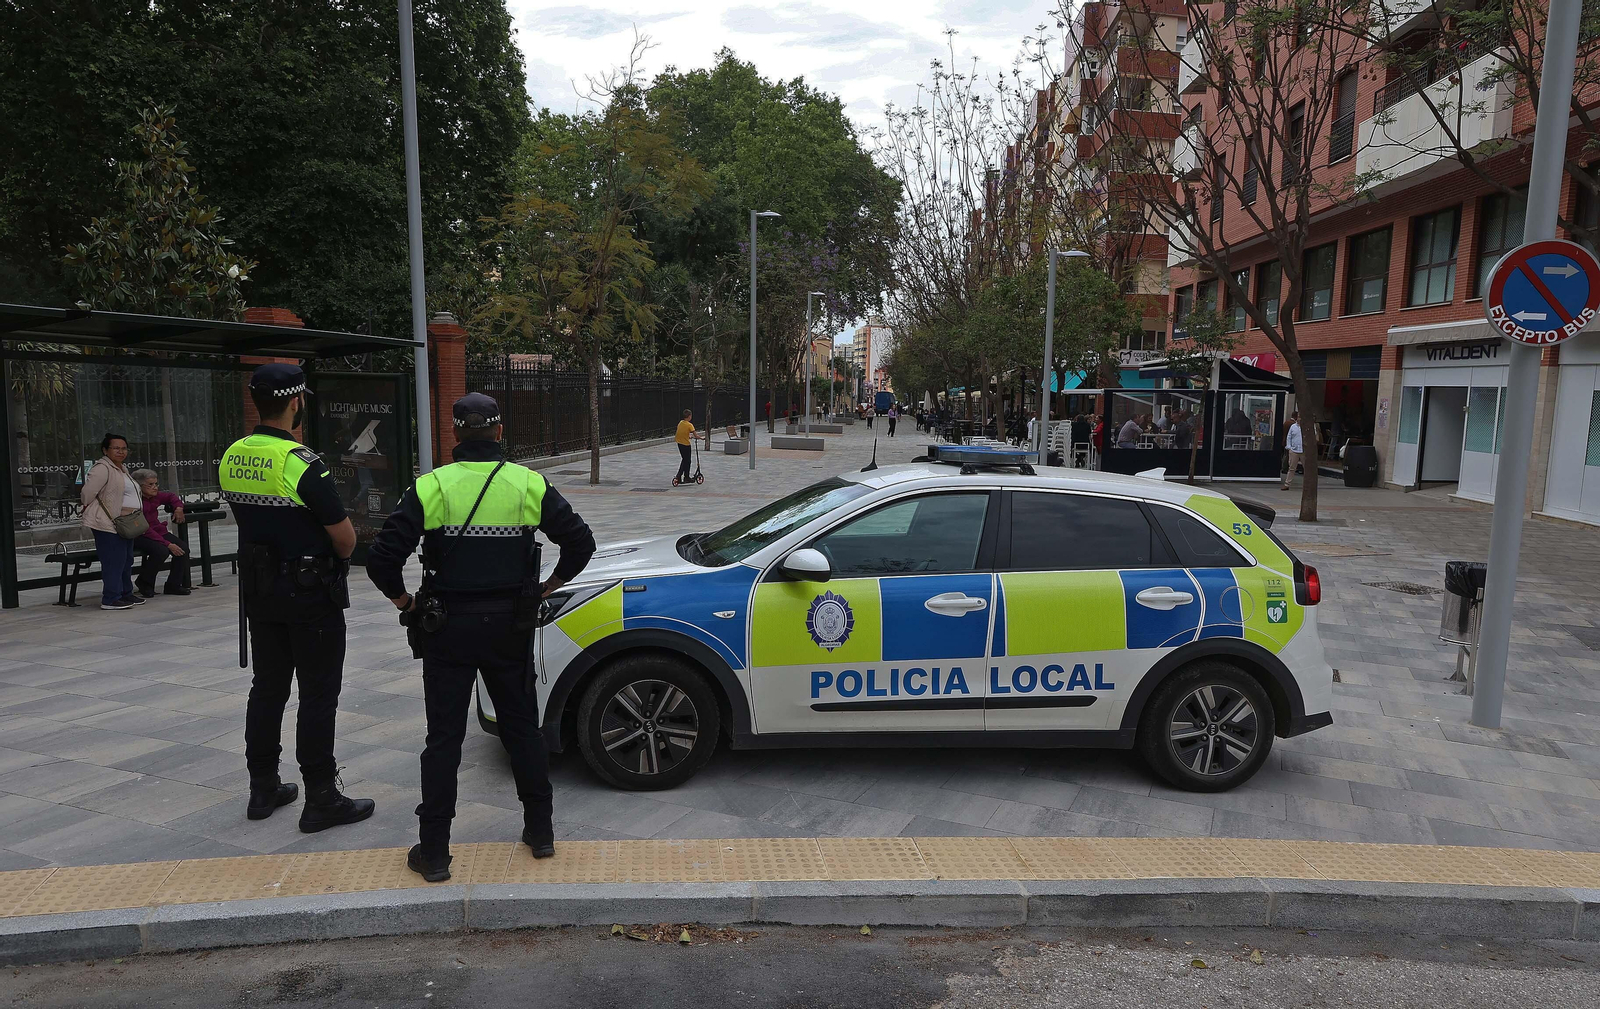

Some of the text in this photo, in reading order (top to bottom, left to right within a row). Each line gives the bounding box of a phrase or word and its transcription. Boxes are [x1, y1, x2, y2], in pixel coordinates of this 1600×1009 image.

[1489, 304, 1596, 344] EXCEPTO BUS
[1426, 344, 1499, 361] VITALDENT
[370, 403, 393, 414] MUSIC
[227, 455, 273, 469] POLICIA
[229, 468, 267, 482] LOCAL
[1232, 523, 1252, 536] 53
[811, 663, 1115, 699] POLICIA LOCAL
